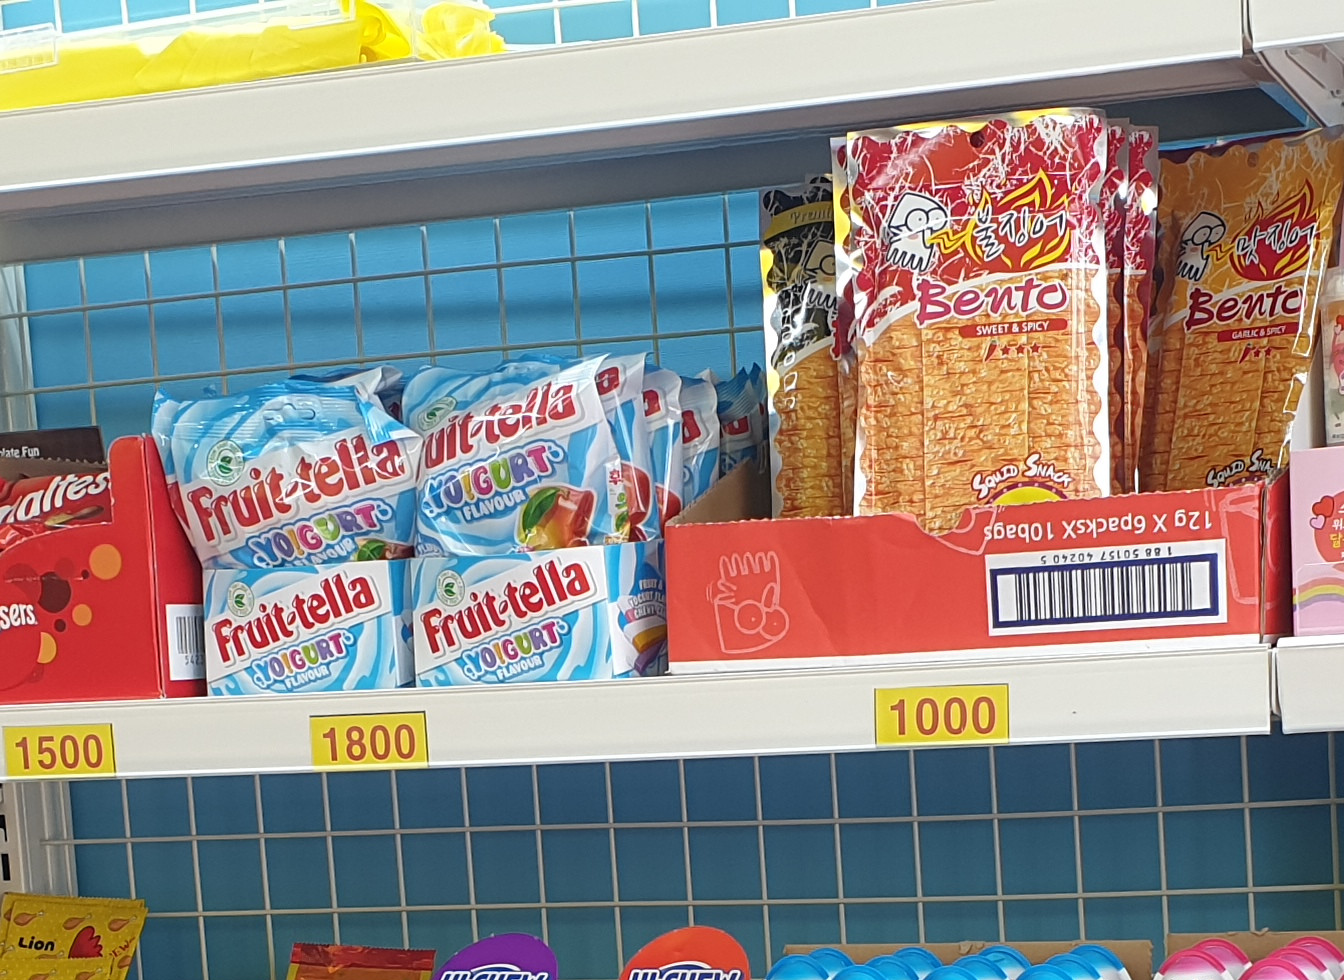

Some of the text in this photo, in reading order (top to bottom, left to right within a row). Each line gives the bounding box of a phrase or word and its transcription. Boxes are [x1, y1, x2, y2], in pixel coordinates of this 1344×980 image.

[916, 278, 1068, 326] Bento
[1185, 285, 1305, 331] Bento
[976, 320, 1049, 335] SWEET & SPICY
[463, 489, 527, 521] FLAVOUR
[984, 522, 1054, 543] 10bags
[1153, 514, 1168, 532] X
[1175, 510, 1212, 530] 12g
[284, 665, 330, 690] FLAVOUR
[496, 655, 543, 681] FLAVOUR
[890, 695, 996, 737] 1000
[15, 734, 104, 772] 1500
[323, 723, 416, 762] 1800
[19, 936, 56, 951] Lion
